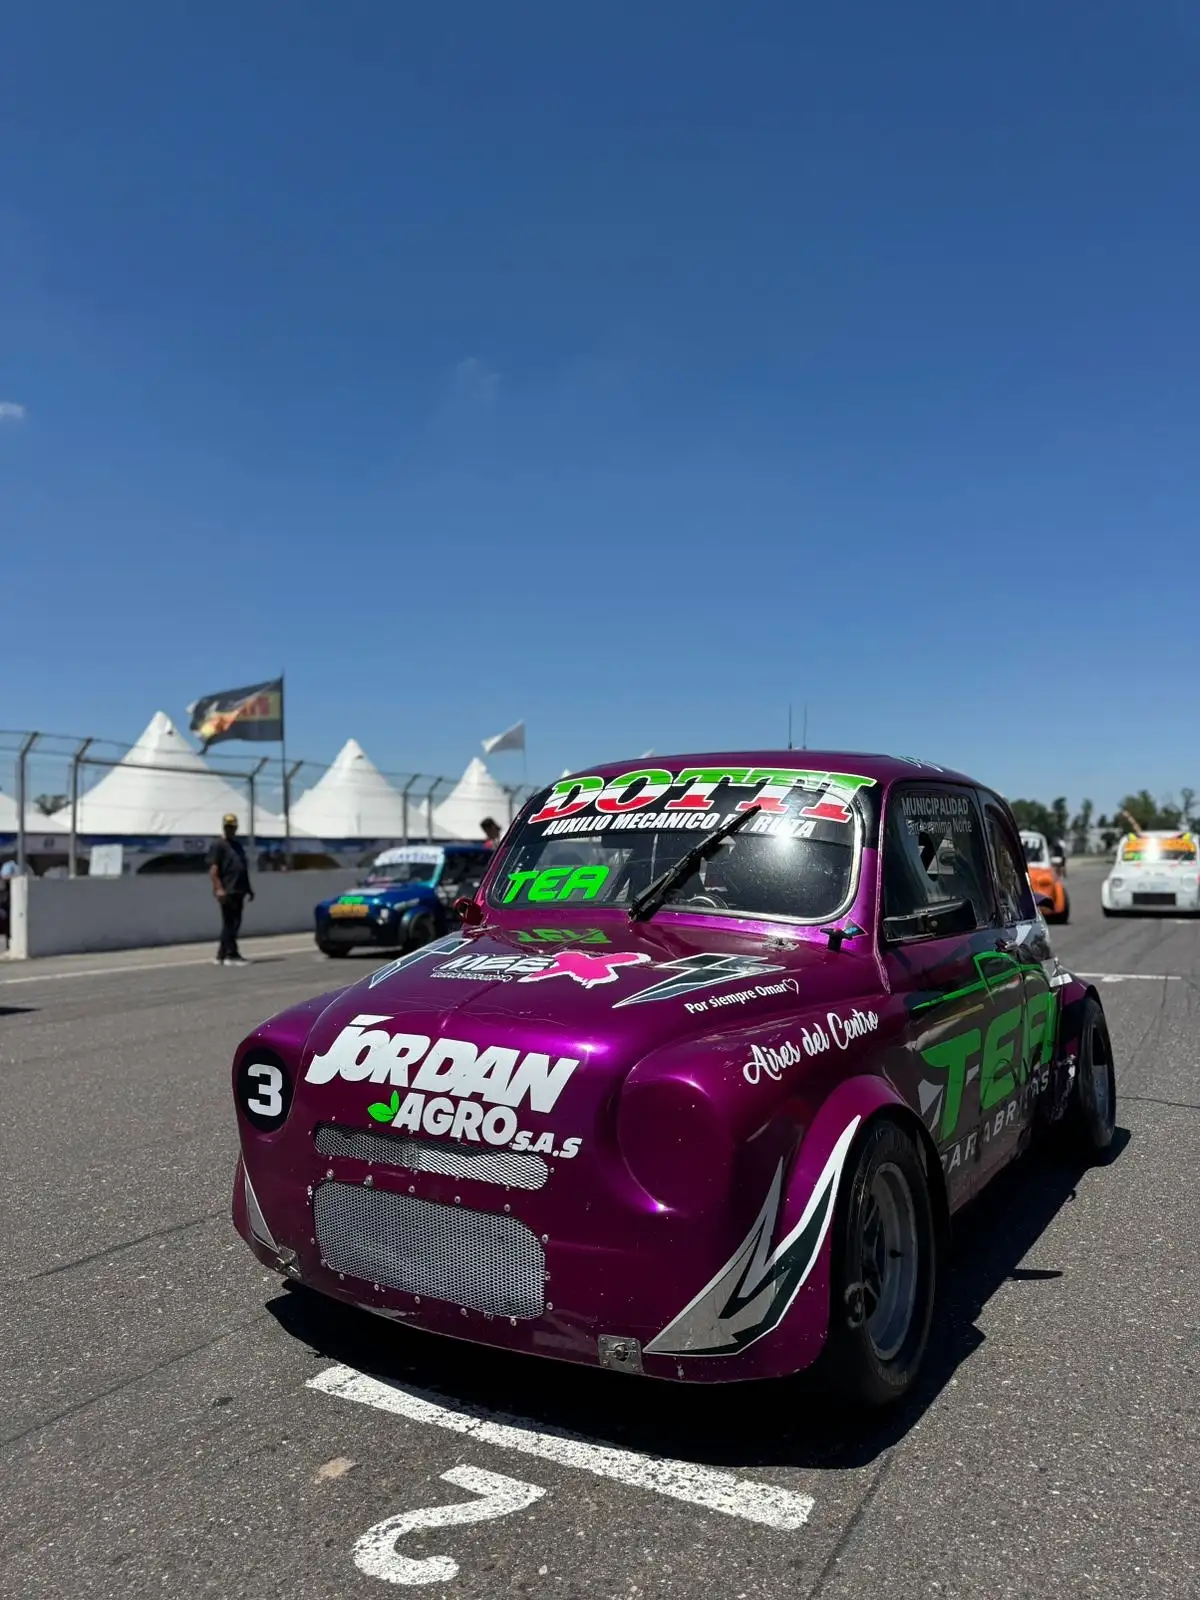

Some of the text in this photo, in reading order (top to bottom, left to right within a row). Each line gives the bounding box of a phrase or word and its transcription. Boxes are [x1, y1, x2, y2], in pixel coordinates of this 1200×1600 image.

[529, 767, 877, 824] DOTTI
[901, 797, 969, 816] MUNICIPALIDAD
[542, 814, 610, 837] AUXILIO
[610, 812, 716, 830] MECANICO
[503, 866, 609, 903] TEA
[684, 982, 787, 1014] Por siempre Omar
[304, 1014, 580, 1113] JORDAN
[743, 1009, 879, 1084] Aires del Centro
[920, 992, 1054, 1141] TEA
[247, 1063, 284, 1118] 3
[391, 1092, 583, 1159] AGRO S.A.S
